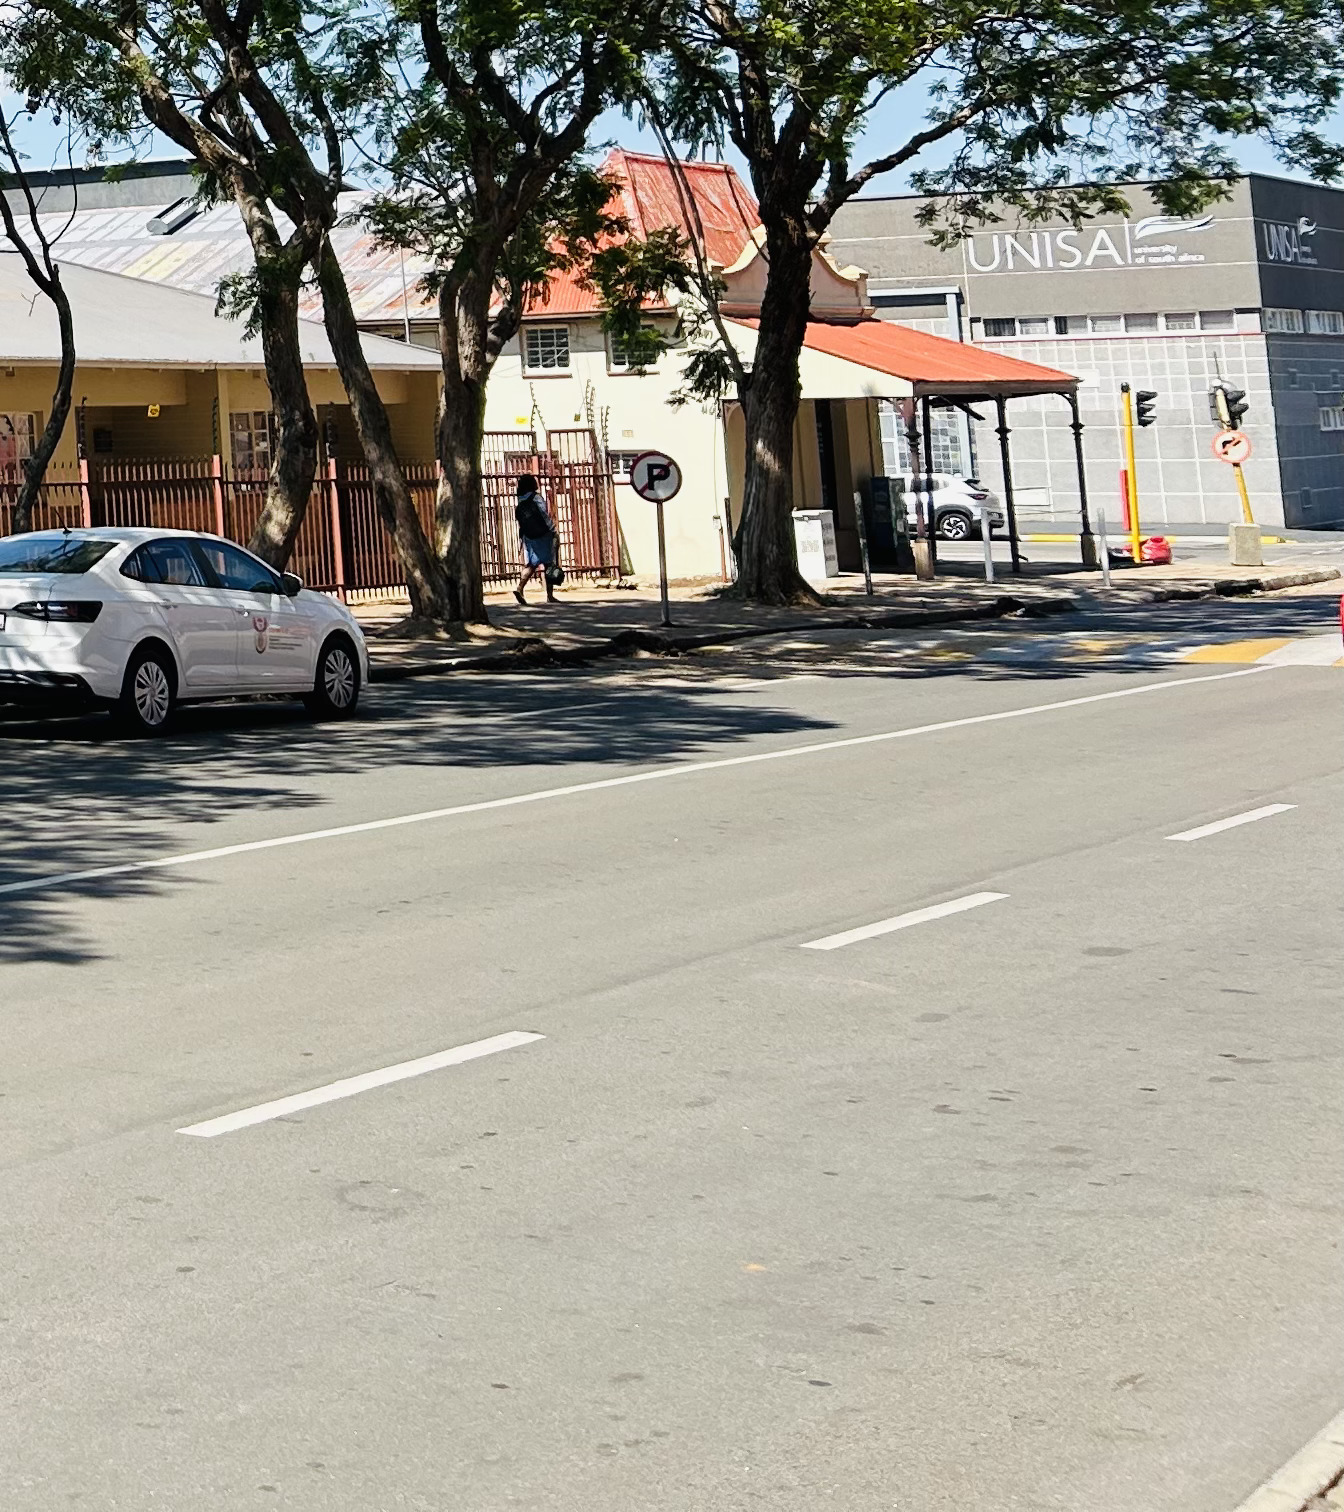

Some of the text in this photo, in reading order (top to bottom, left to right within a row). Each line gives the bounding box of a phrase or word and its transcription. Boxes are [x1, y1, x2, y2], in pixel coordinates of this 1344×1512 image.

[967, 229, 1126, 272] UNISA
[1261, 222, 1301, 263] UNISA
[647, 463, 671, 491] P
